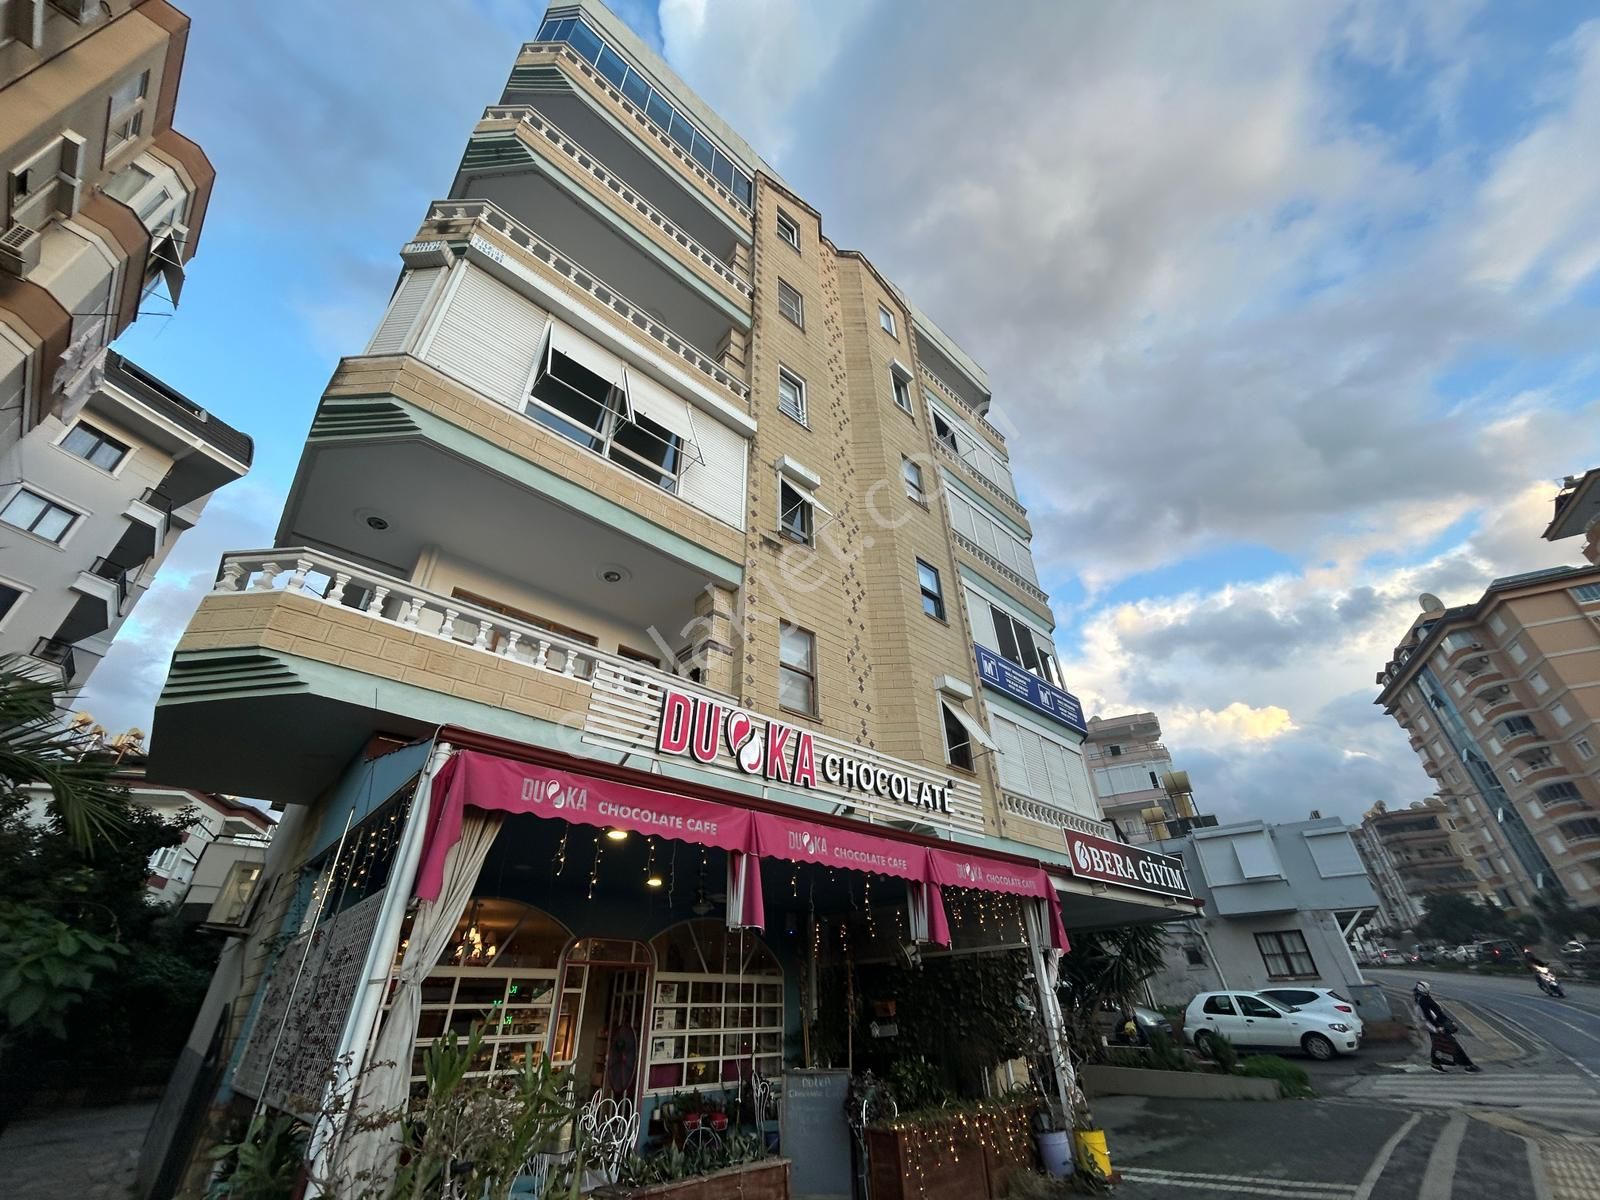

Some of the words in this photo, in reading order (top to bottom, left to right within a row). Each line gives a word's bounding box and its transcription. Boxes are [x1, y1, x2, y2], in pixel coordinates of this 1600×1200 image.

[822, 753, 955, 814] CHOCOLATE
[598, 801, 683, 830] CHOCOLATE
[686, 818, 718, 836] CAFE
[833, 847, 886, 867] CHOCOLATE
[887, 856, 908, 870] CAFE
[1087, 846, 1140, 881] BERA
[1139, 855, 1187, 891] GİYİM
[985, 873, 1021, 888] CHOCOLATE
